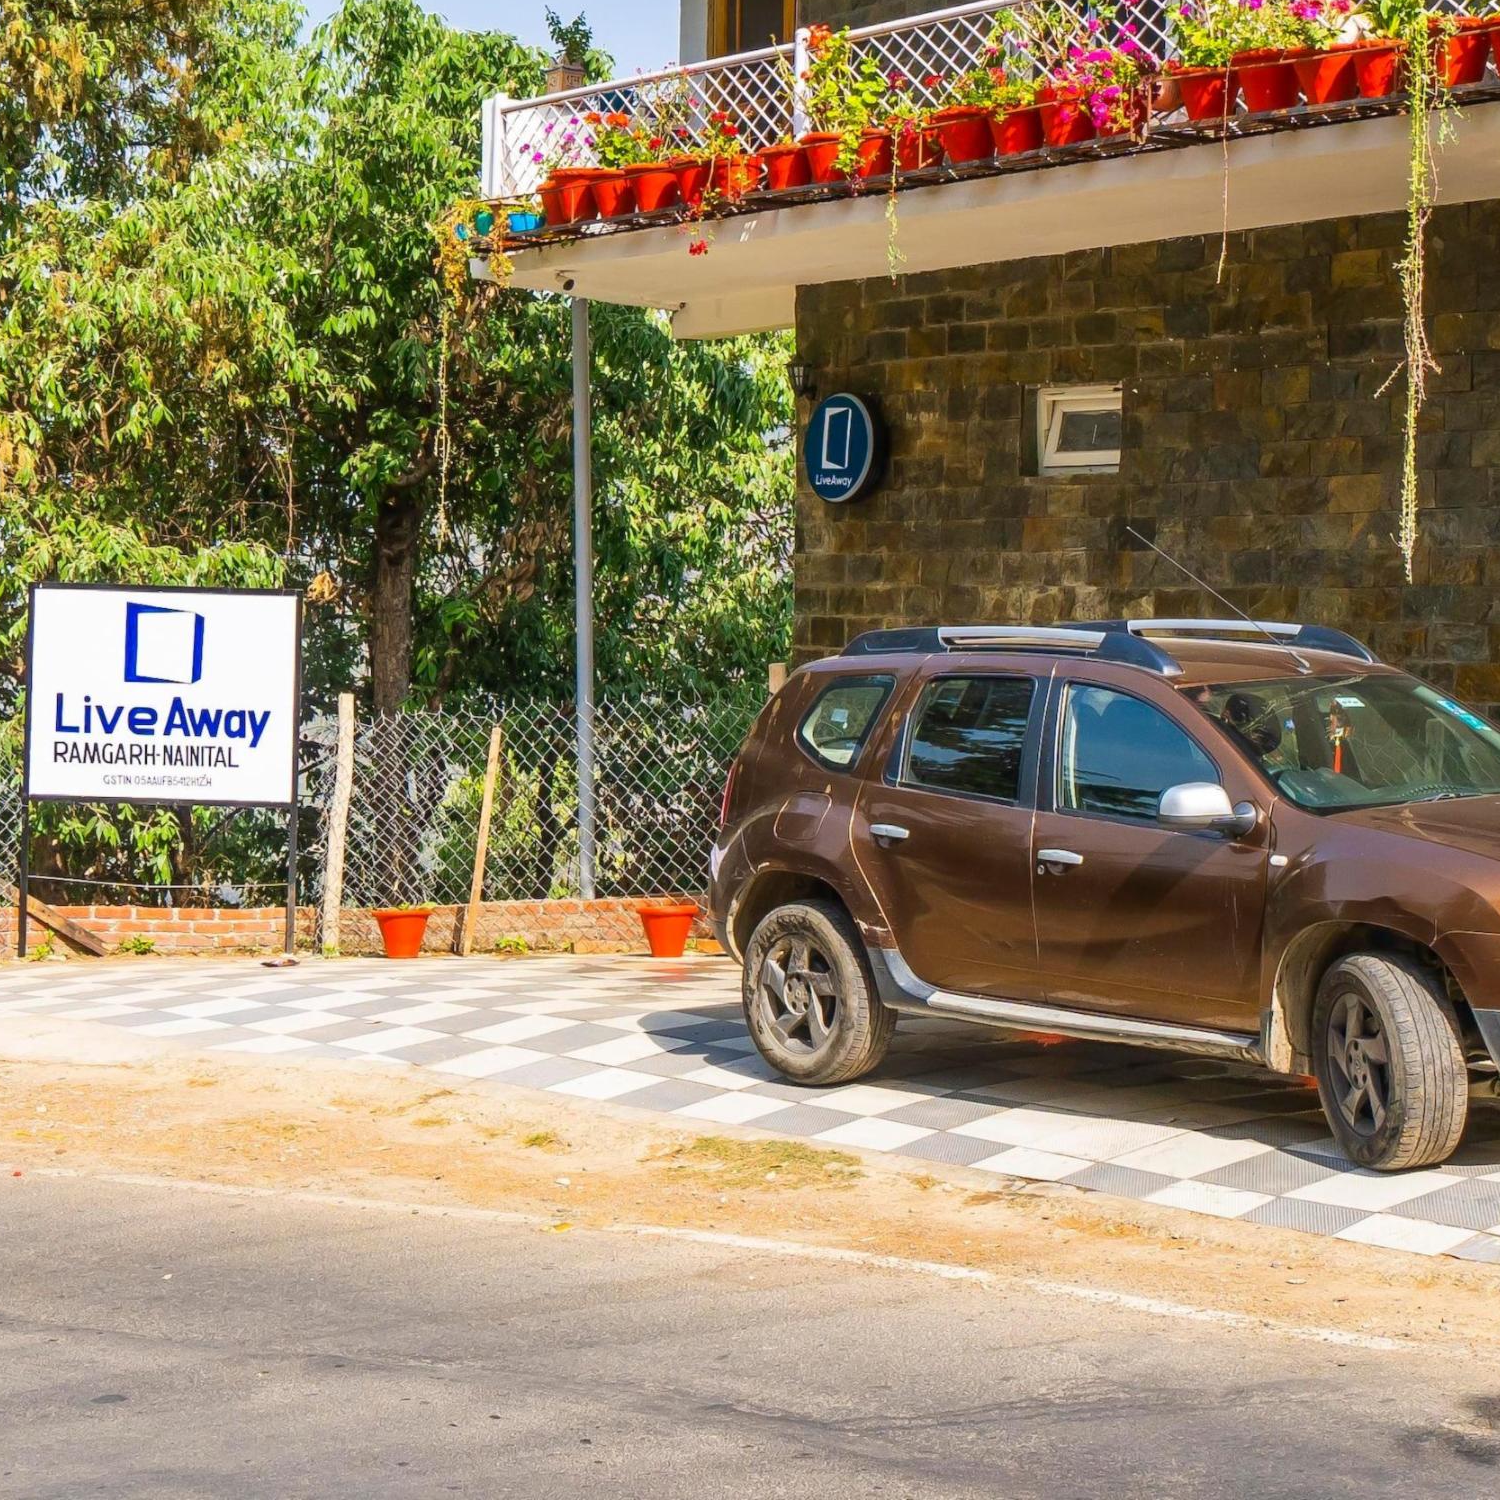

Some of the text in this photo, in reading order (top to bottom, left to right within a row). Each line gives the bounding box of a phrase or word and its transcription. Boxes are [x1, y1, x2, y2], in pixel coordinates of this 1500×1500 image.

[815, 474, 852, 489] LiveAway
[53, 740, 240, 769] RAMGARH-NAINITAL
[102, 774, 132, 785] GSTIN
